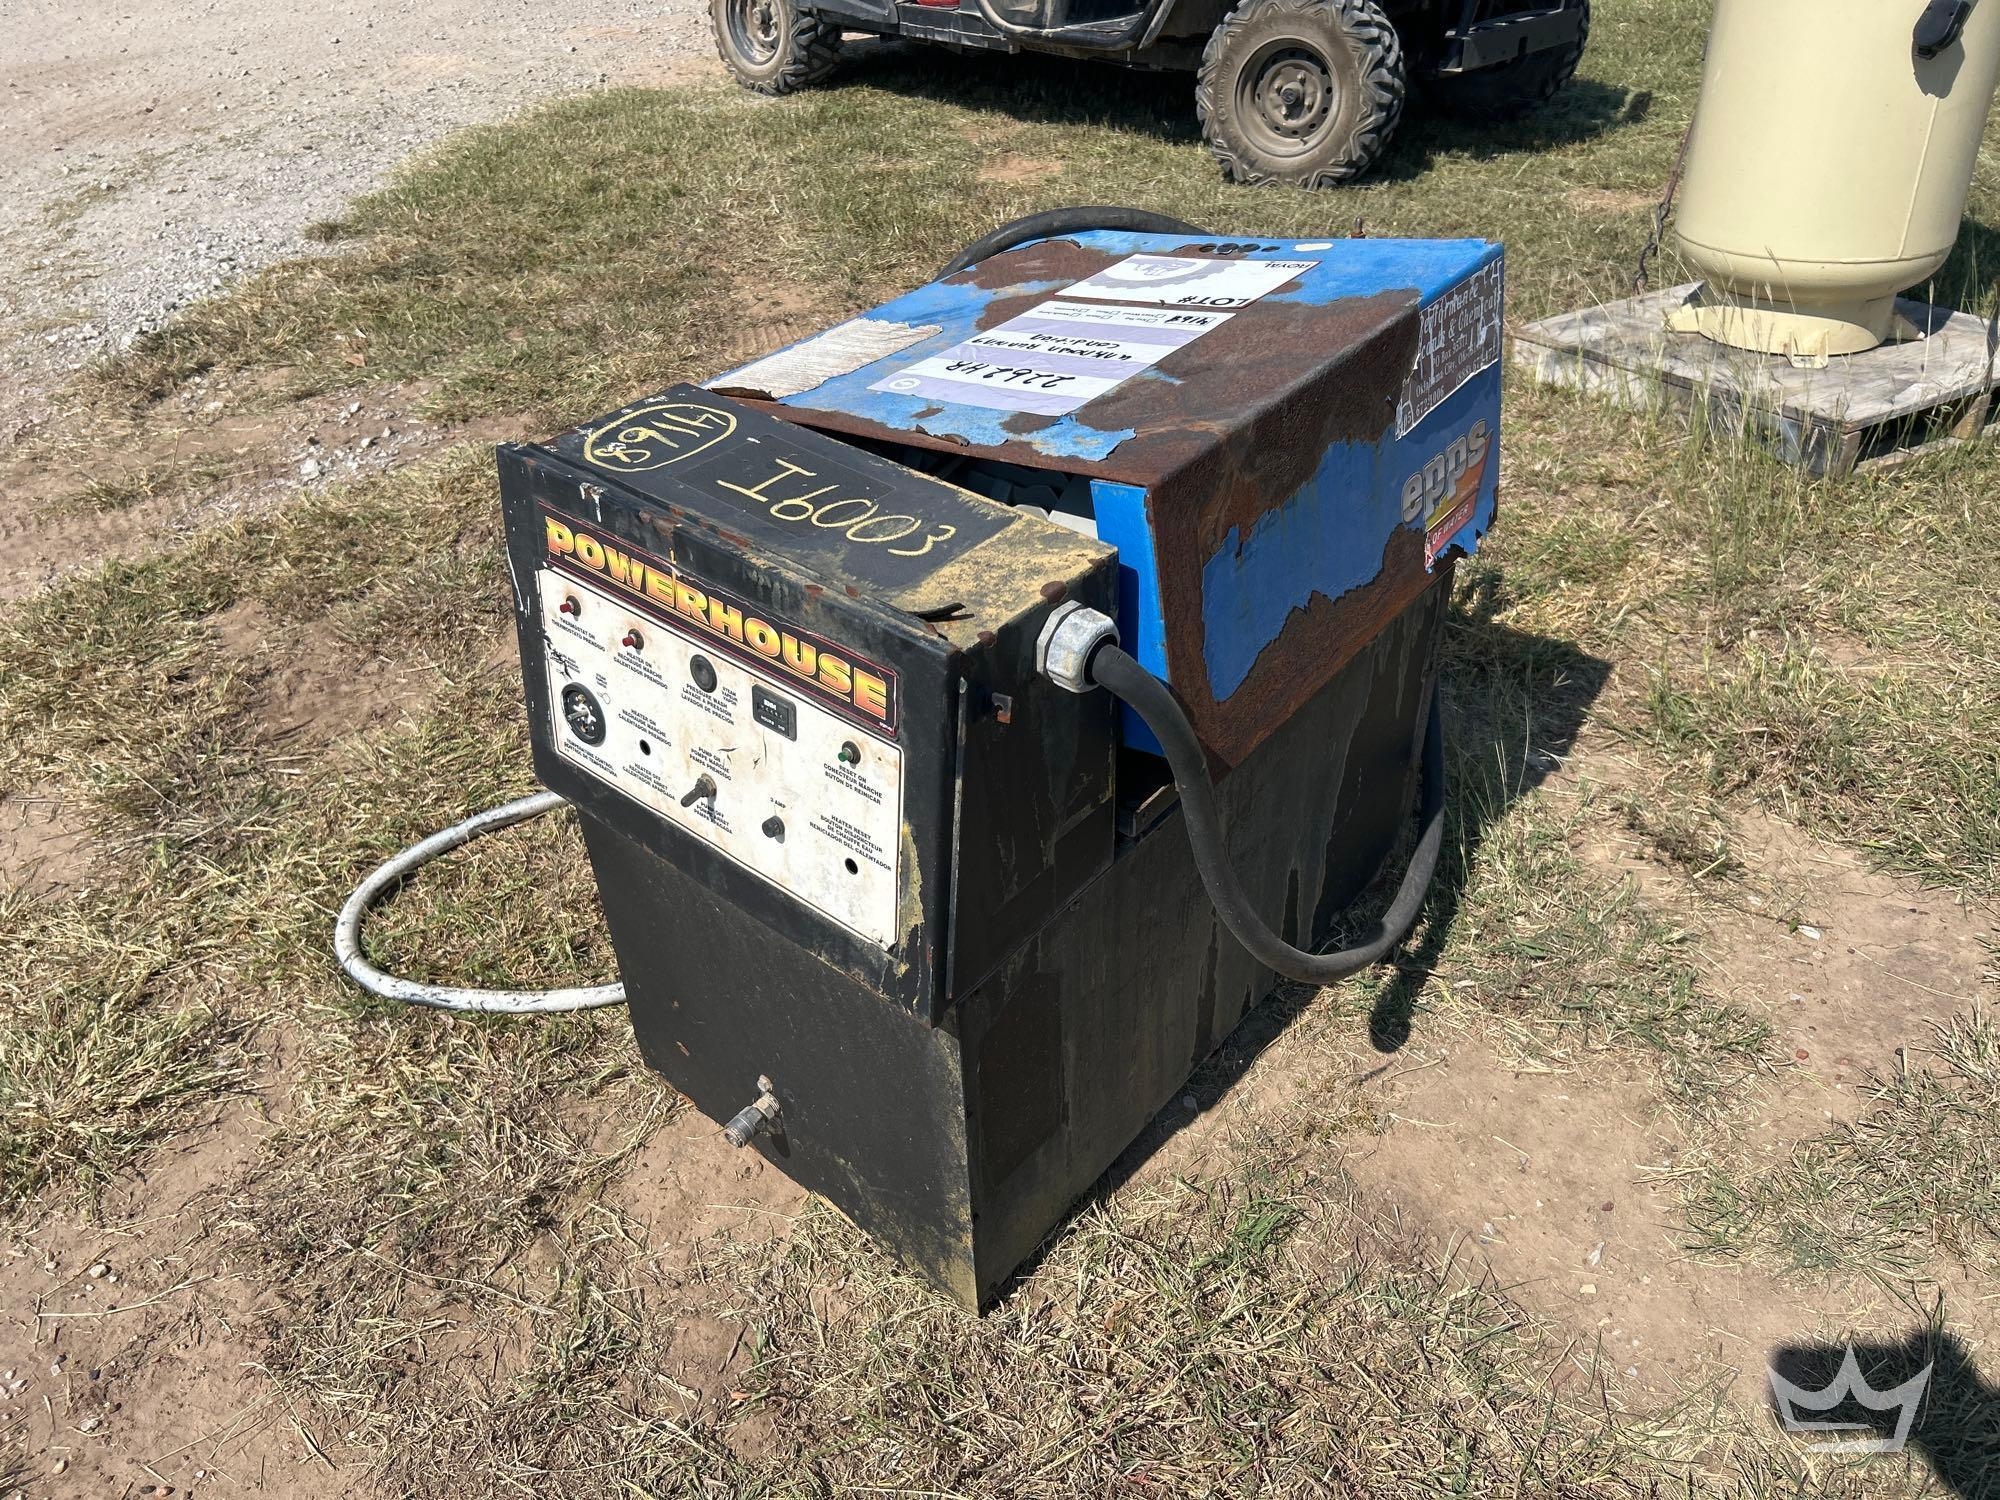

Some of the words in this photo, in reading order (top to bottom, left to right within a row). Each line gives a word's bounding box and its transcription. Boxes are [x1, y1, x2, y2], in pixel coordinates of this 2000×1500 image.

[1178, 295, 1251, 307] LOT#
[983, 367, 1075, 388] 2262
[545, 515, 888, 721] POWERHOUSE
[681, 693, 703, 710] LAVADOR
[687, 684, 712, 701] PRESSURE
[714, 698, 727, 709] WASH
[707, 700, 731, 718] PRESSION
[699, 747, 712, 758] PUMP
[839, 765, 856, 778] RESET
[858, 775, 866, 784] ON
[859, 782, 882, 799] MARCHE
[821, 815, 842, 831] BOUTON
[844, 828, 882, 853] DISJONCTEUR
[832, 815, 852, 830] HEATER
[854, 827, 871, 841] RESET
[836, 830, 860, 847] CHAUFFE
[862, 844, 872, 854] EAU
[844, 840, 854, 850] DEL
[855, 847, 891, 872] CALENTADOR
